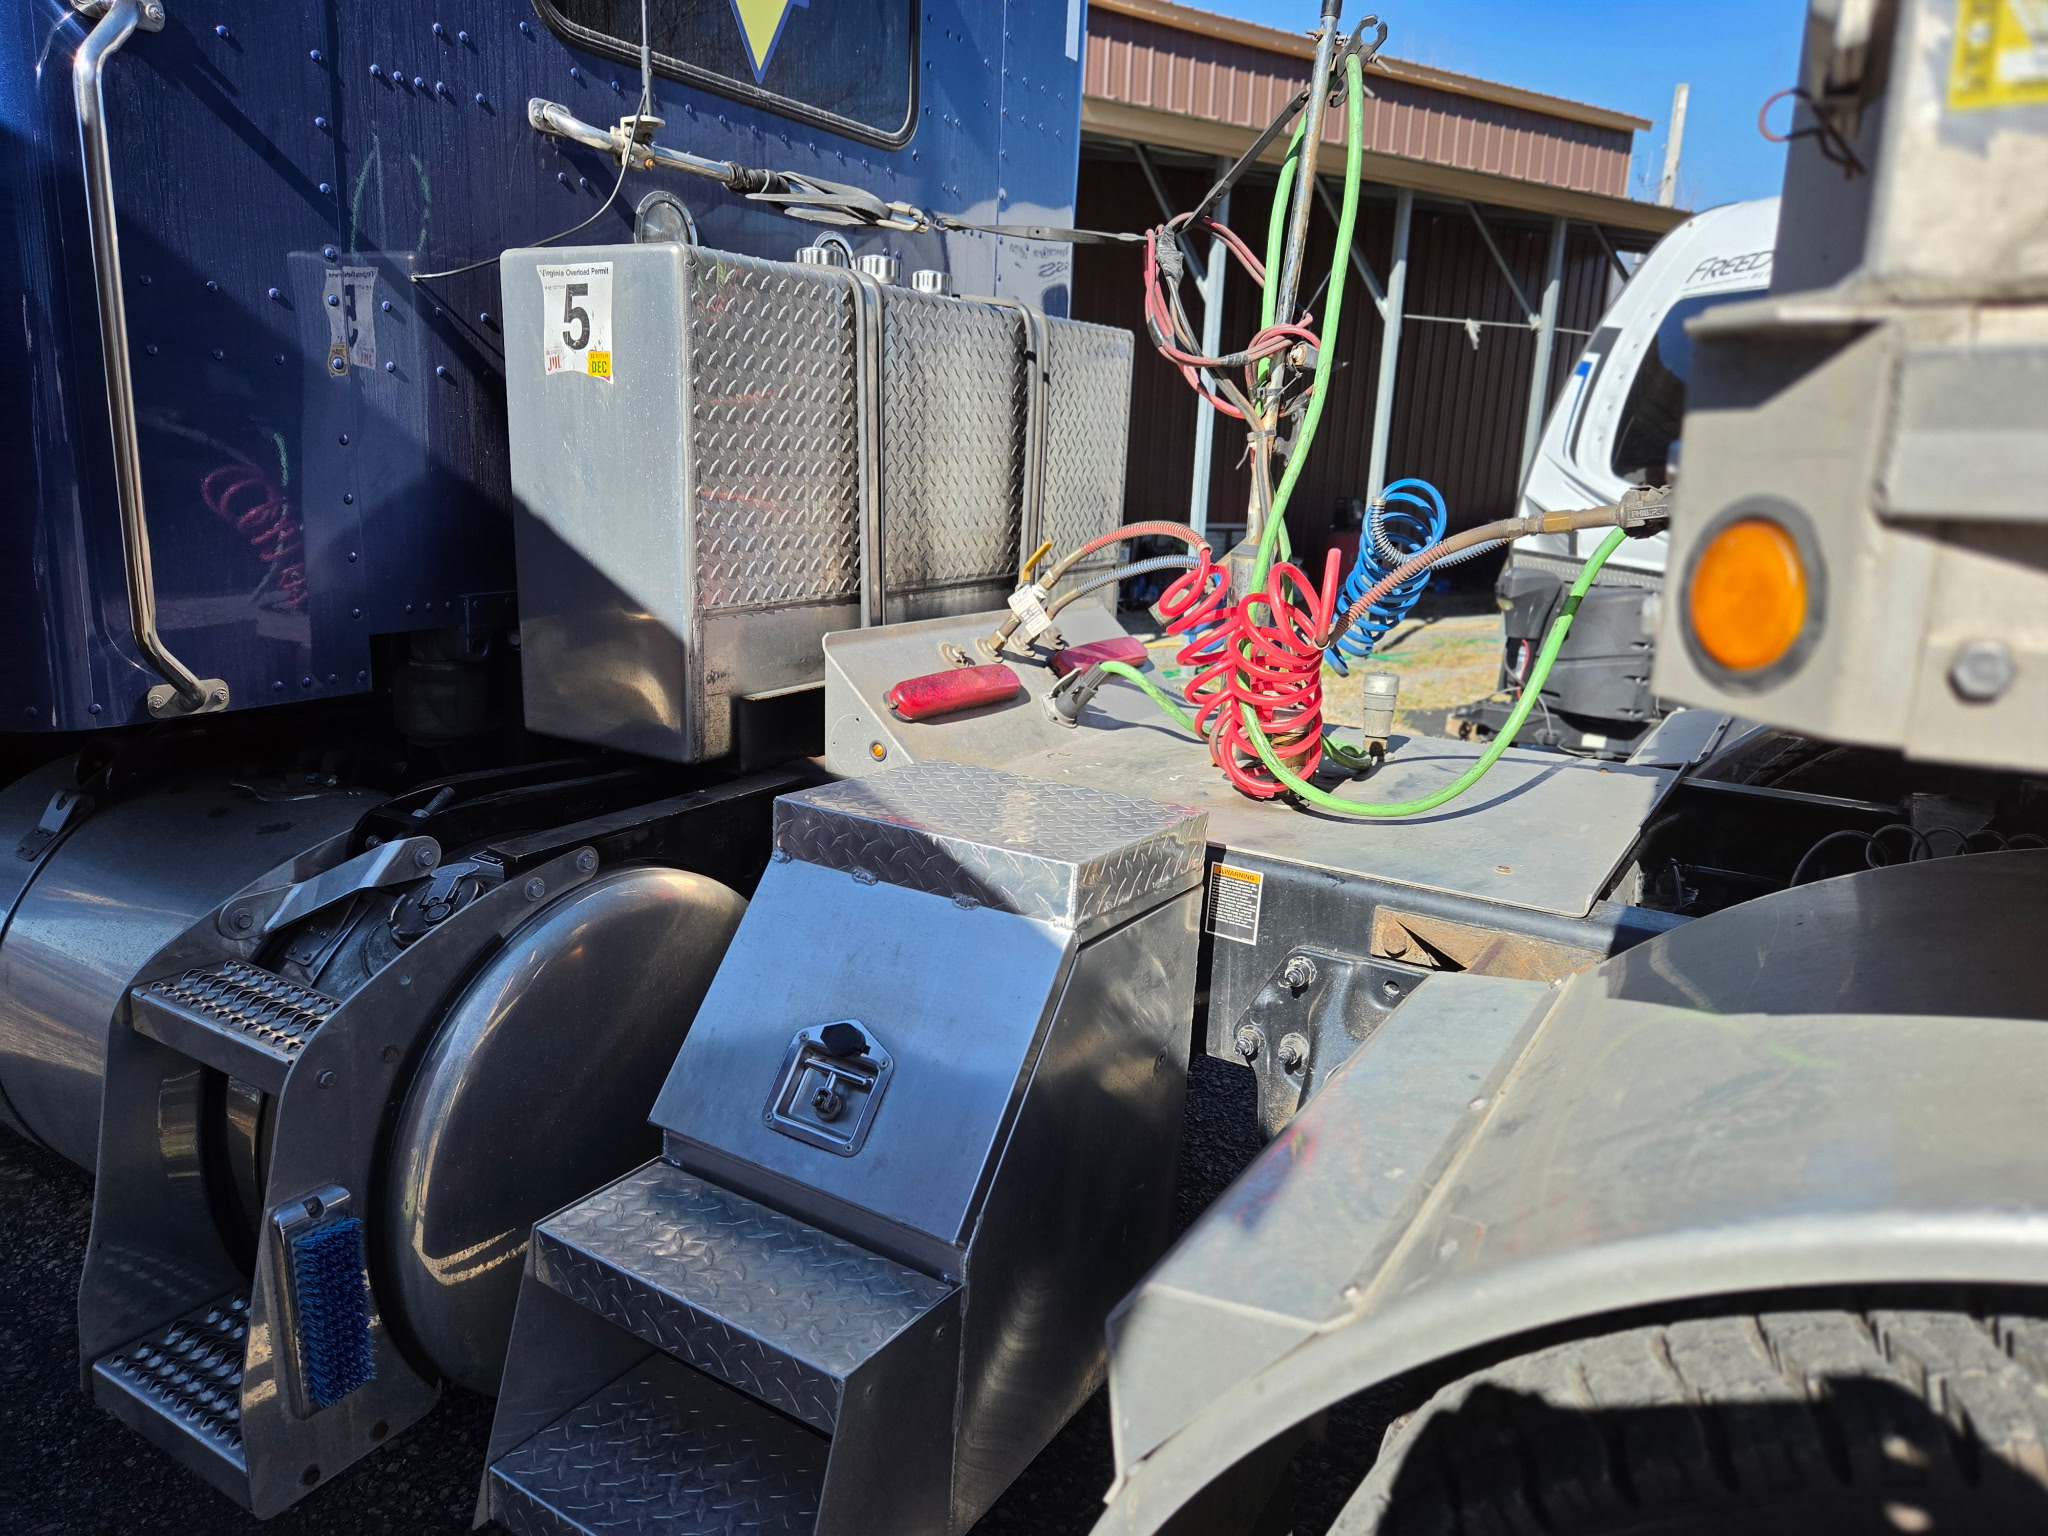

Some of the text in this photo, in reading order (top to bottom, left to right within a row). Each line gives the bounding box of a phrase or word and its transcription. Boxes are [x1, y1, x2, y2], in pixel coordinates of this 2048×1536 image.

[540, 266, 609, 279] Virginia Overload Permit
[562, 283, 591, 351] 5
[591, 360, 607, 374] DEC
[1224, 868, 1255, 882] WARNING
